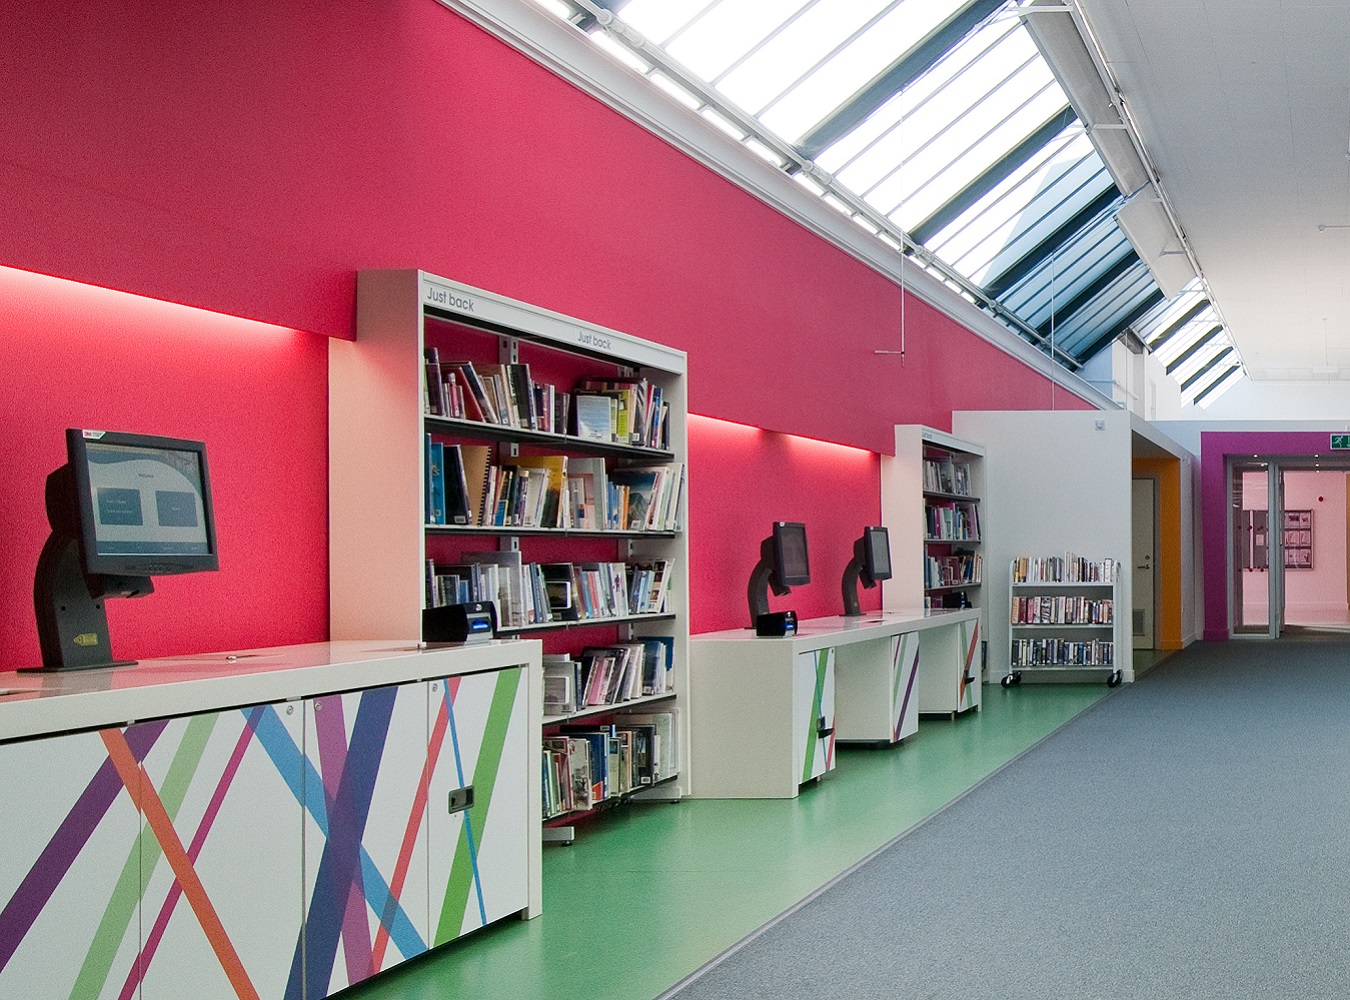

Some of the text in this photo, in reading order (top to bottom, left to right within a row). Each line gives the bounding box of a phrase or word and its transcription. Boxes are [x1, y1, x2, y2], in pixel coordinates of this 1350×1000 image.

[427, 288, 474, 312] Just back
[577, 331, 611, 350] Just back
